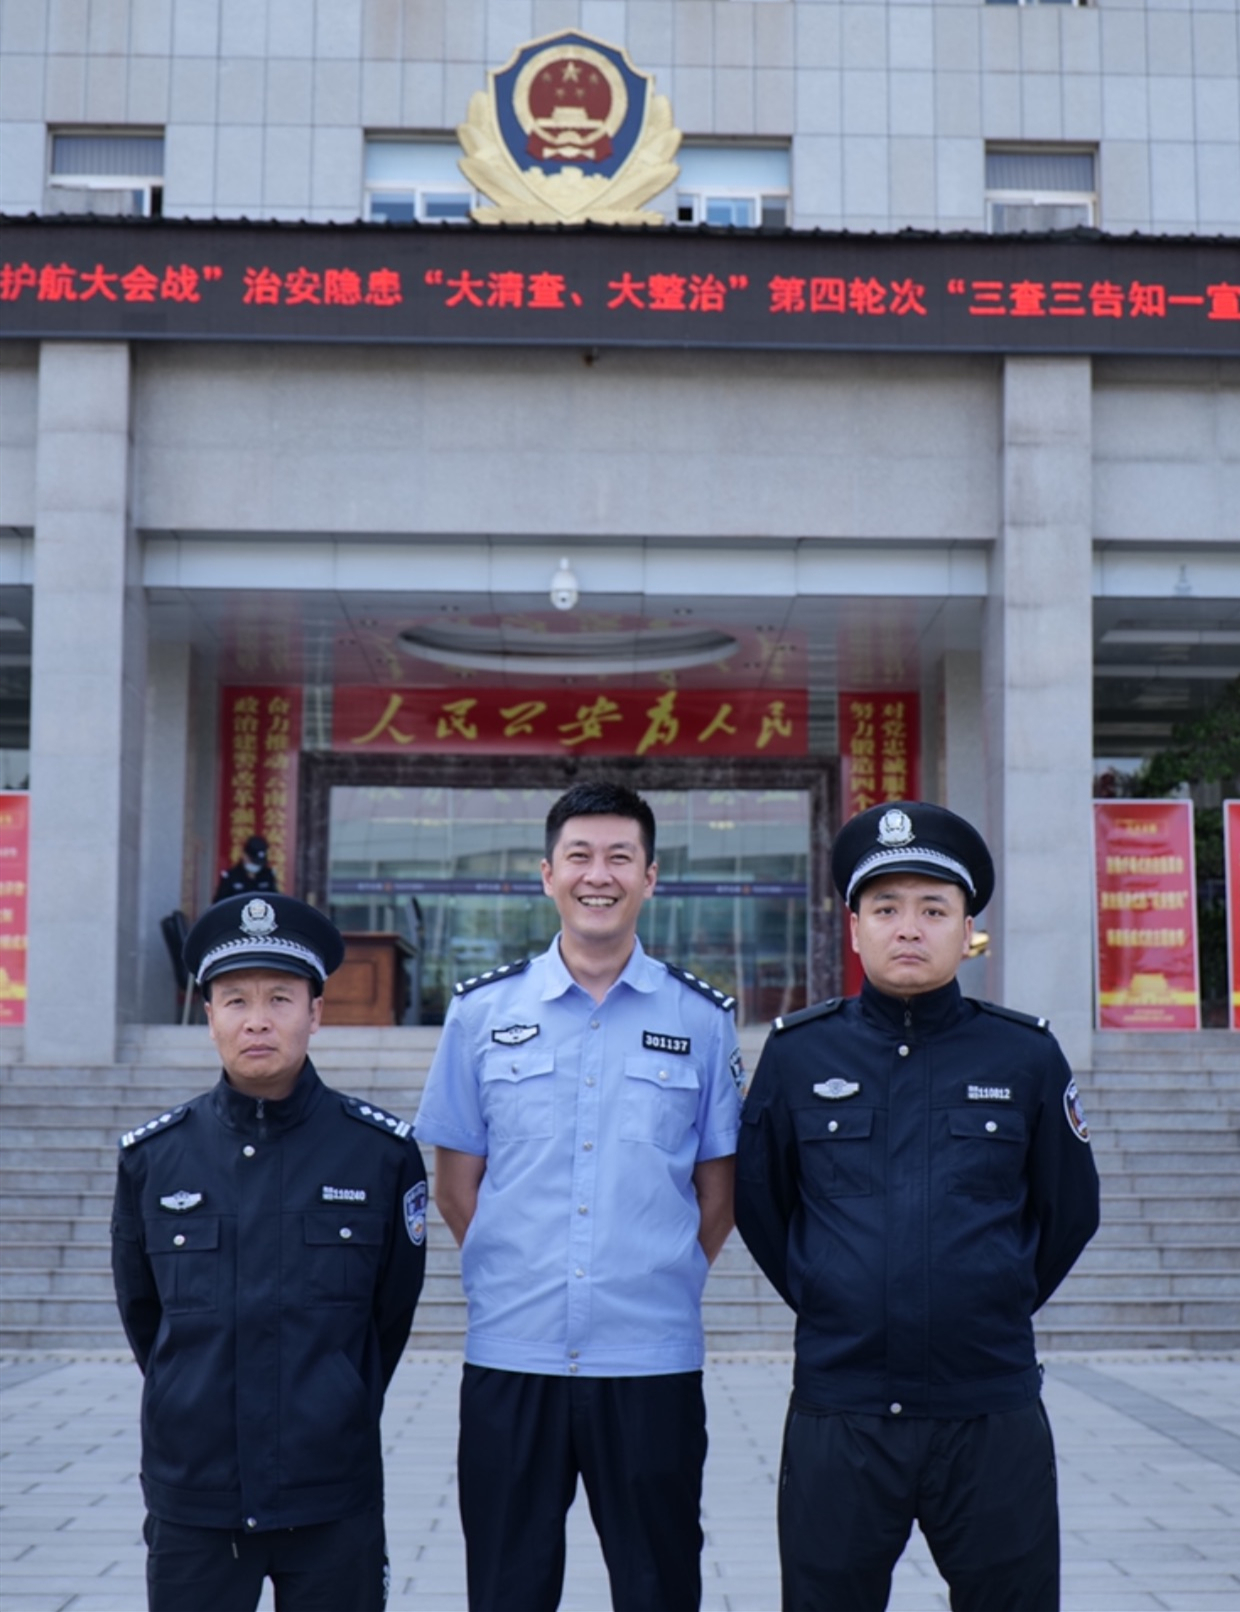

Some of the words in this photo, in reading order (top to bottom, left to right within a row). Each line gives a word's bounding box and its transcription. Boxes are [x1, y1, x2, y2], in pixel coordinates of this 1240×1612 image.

[351, 690, 794, 755] 人民公安为人民
[645, 1034, 689, 1053] 301137
